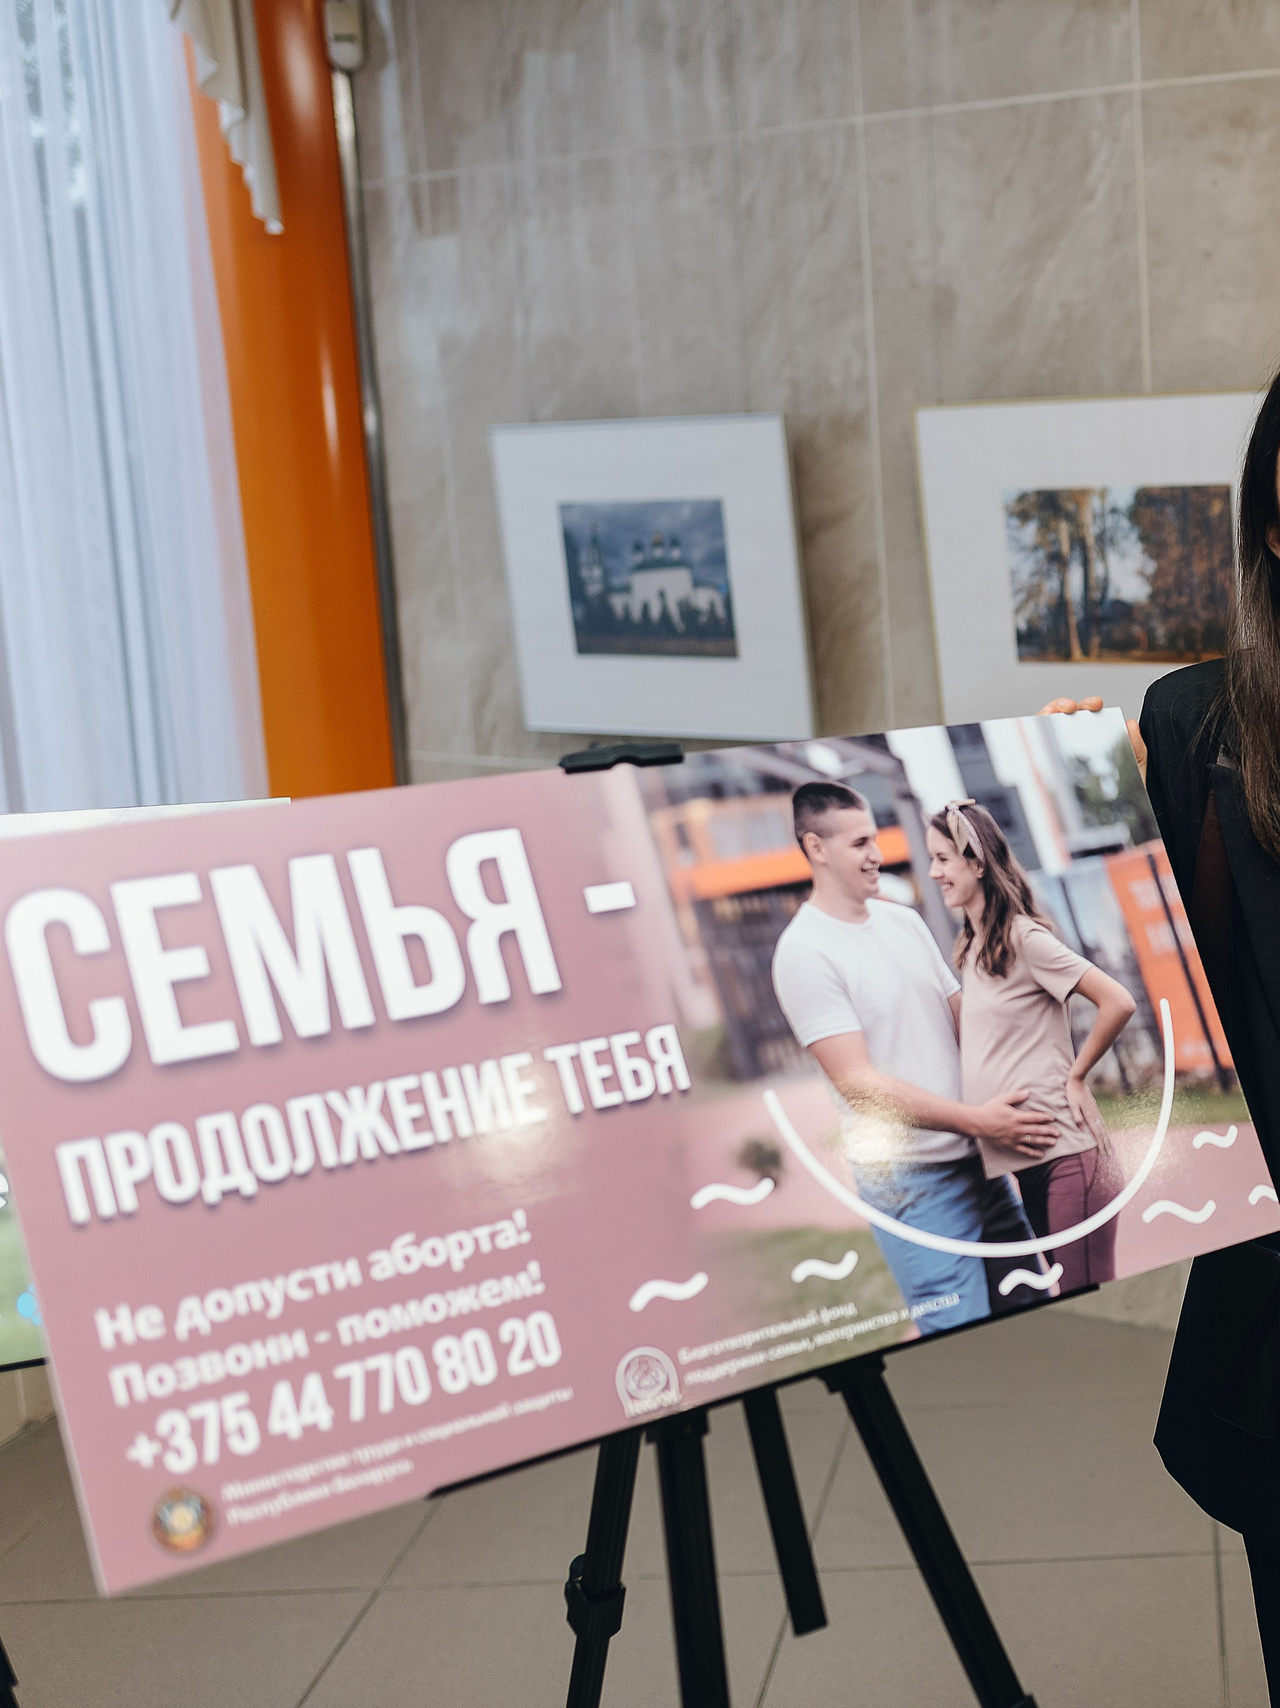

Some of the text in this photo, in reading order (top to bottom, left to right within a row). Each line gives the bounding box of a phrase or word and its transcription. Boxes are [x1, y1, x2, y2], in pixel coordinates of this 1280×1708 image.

[4, 827, 562, 1083] СЕМЬЯ
[55, 1024, 692, 1224] ПРОДОЛЖЕНИЕ ТЕБЯ
[95, 1209, 533, 1350] Не допусти аборта!
[109, 1328, 310, 1407] Позвони
[337, 1261, 546, 1347] поможем!
[127, 1310, 563, 1474] +375 44 770 80 20
